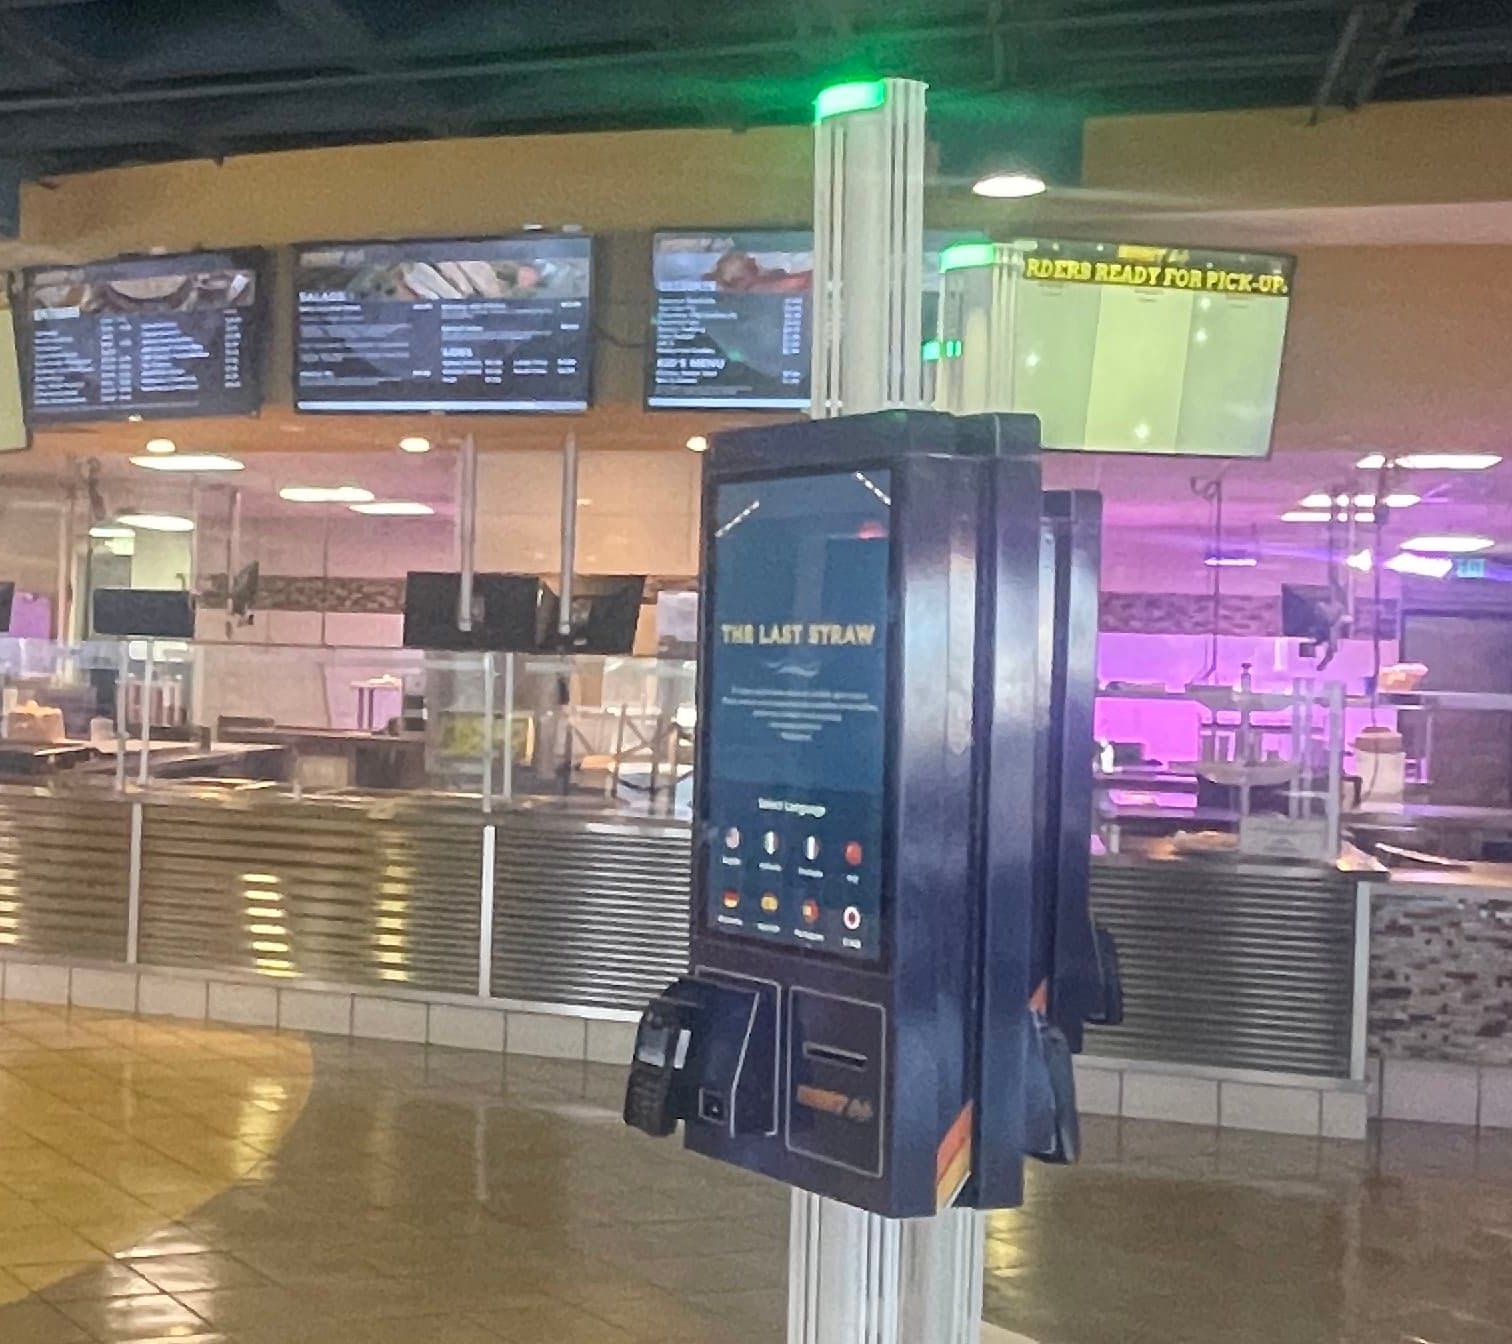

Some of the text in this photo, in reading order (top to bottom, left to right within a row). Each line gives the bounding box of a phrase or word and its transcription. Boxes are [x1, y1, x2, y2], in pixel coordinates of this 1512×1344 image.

[1026, 258, 1092, 280] RDERS
[1094, 262, 1162, 286] READY
[1164, 267, 1203, 288] FOR
[721, 623, 876, 646] THE LAST STRAW
